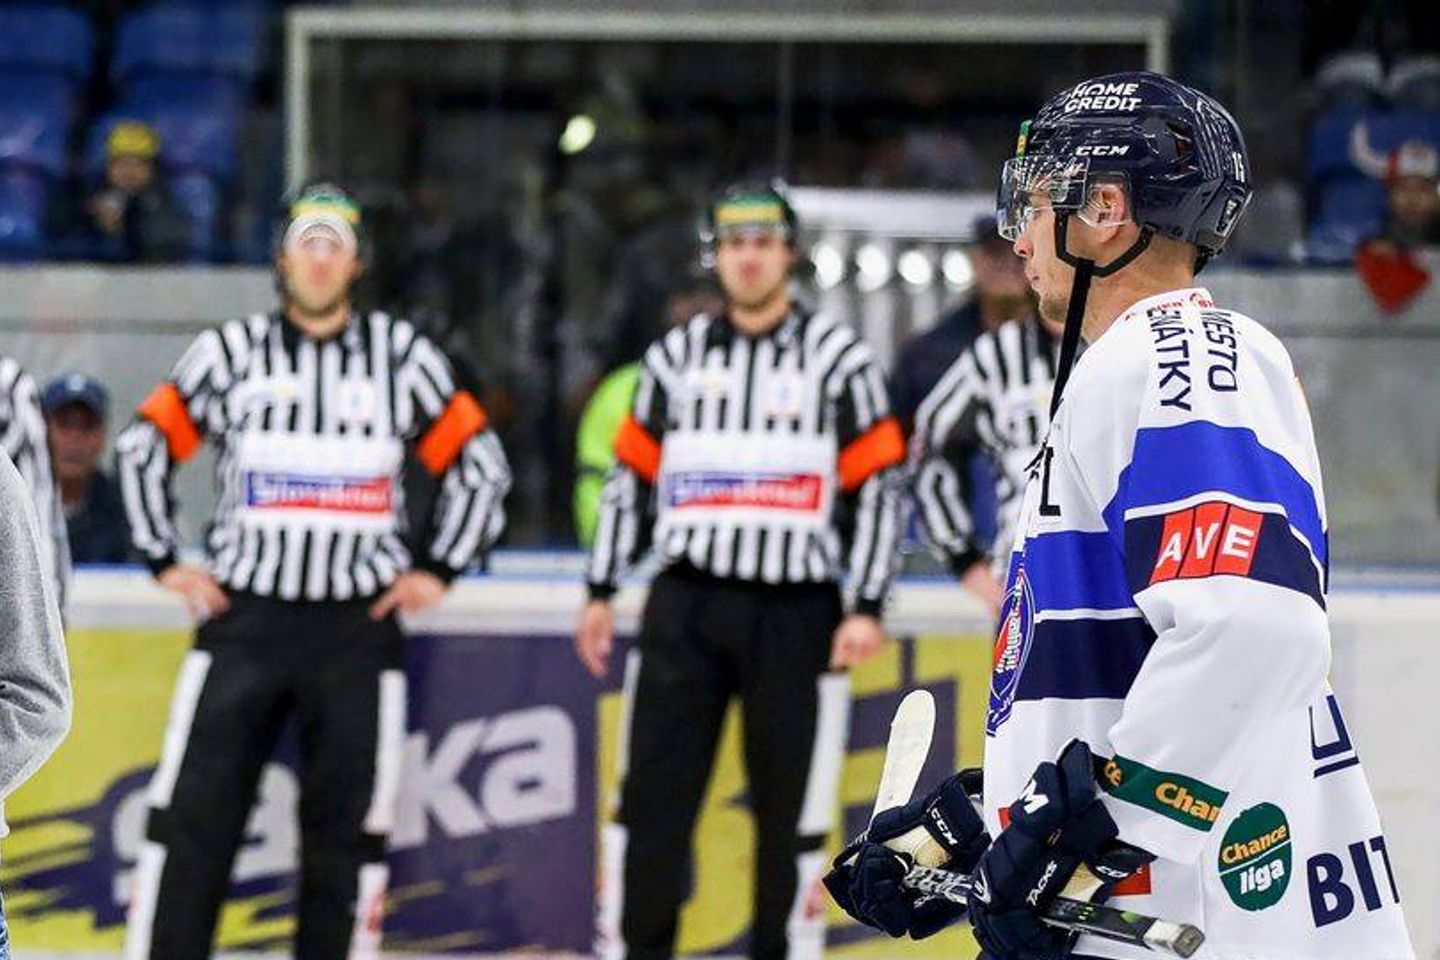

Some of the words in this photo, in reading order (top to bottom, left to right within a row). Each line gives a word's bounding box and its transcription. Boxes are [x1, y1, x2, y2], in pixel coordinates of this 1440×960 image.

[1064, 96, 1143, 113] CREDIT
[1071, 81, 1140, 98] HOME
[1075, 145, 1130, 157] CCM
[1155, 521, 1256, 569] AVE
[926, 805, 959, 846] CCM
[1221, 824, 1288, 864] Chance
[1239, 858, 1285, 895] liga
